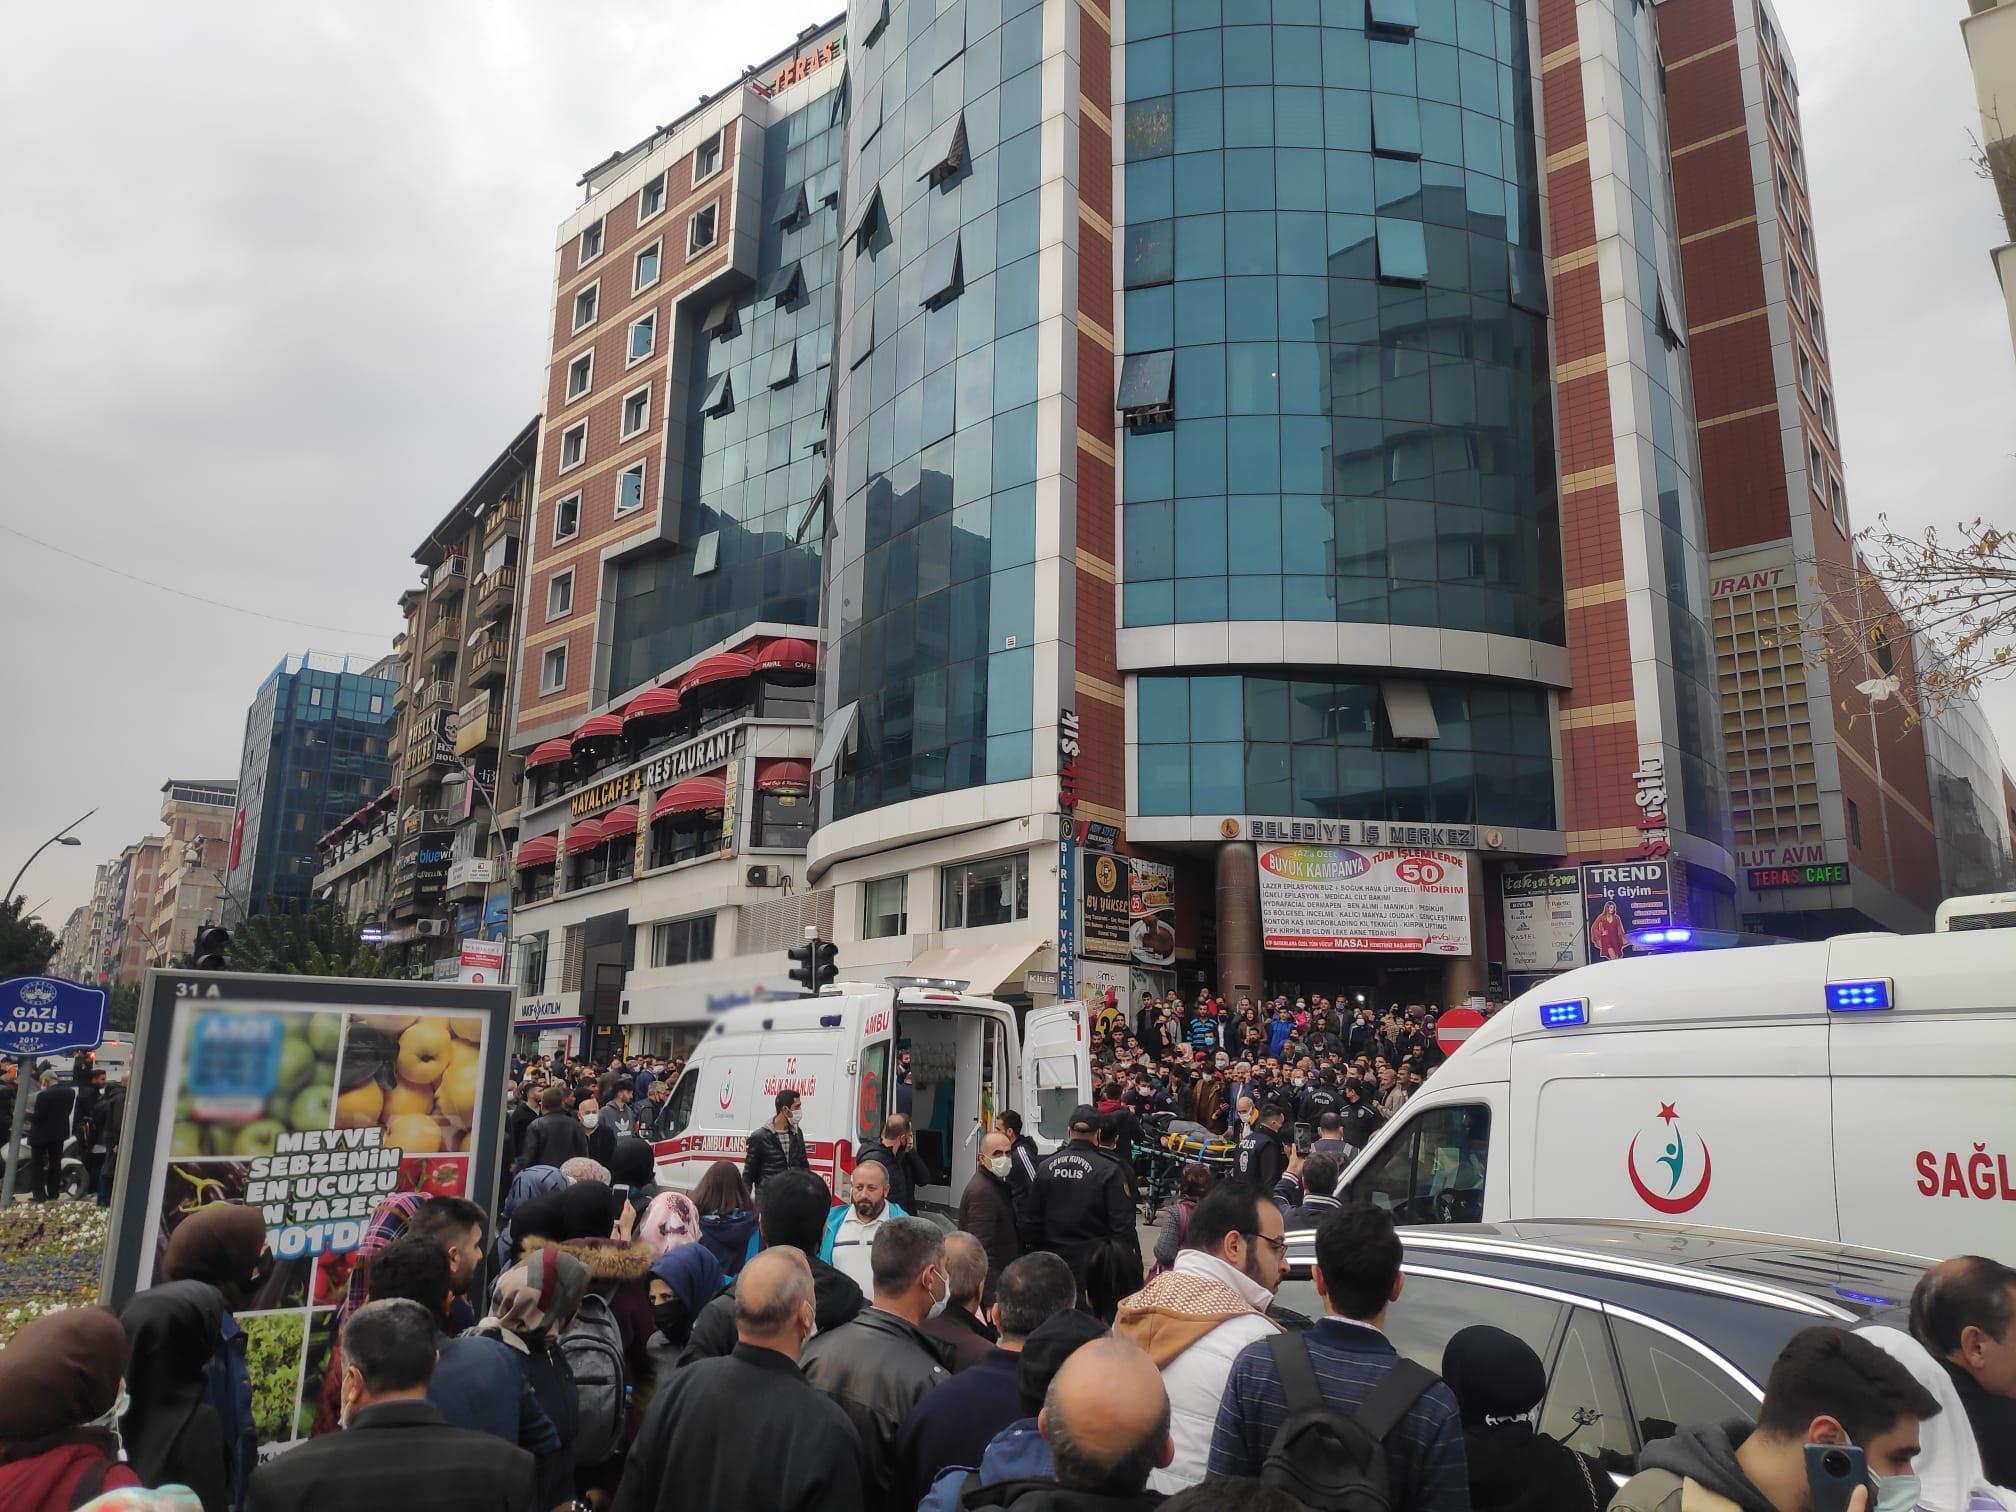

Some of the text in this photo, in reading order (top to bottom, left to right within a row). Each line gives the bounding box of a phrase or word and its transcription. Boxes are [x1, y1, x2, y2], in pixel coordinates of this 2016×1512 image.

[774, 40, 833, 93] TERAS
[795, 661, 812, 669] CAFE
[407, 739, 433, 769] HOUSE
[633, 769, 641, 792] &
[646, 729, 736, 786] RESTAURANT
[1251, 819, 1476, 846] BELEDİYE İŞ MERKEZİ
[1316, 849, 1337, 858] ÖZEL
[1372, 847, 1463, 868] TÜM İŞLEMLERDE
[1736, 845, 1823, 867] LUT AVM
[1269, 852, 1364, 878] BÜYÜK KAMPANYA
[1402, 864, 1439, 883] 50
[1591, 865, 1662, 883] TREND
[1753, 866, 1841, 887] TERAS CAFE
[1262, 882, 1282, 890] LAZER
[1341, 884, 1364, 892] SOĞUK
[1603, 885, 1652, 899] İç Giyim
[1100, 895, 1128, 913] YÜKSEL
[1273, 909, 1305, 917] BÖLGESEL
[1307, 901, 1342, 909] DERMAPEN
[1060, 841, 1068, 996] BİRLİK VAKFI
[1291, 919, 1304, 927] KAŞ
[1334, 939, 1369, 948] MASAJ
[1029, 973, 1056, 984] KİLİS
[175, 983, 220, 997] 31 A
[12, 1005, 57, 1019] GAZİ
[522, 1002, 561, 1017] VAKIF KATILIM
[0, 1020, 73, 1034] ADDESİ
[864, 1010, 890, 1035] AMBU
[19, 1036, 40, 1044] 2017
[786, 1056, 797, 1075] T.C.
[763, 1074, 816, 1097] SAĞLIK BAKANLIĞI
[276, 1126, 382, 1153] MEYVE
[1069, 1155, 1093, 1174] KUVVET
[246, 1170, 398, 1203] EN UCUZU
